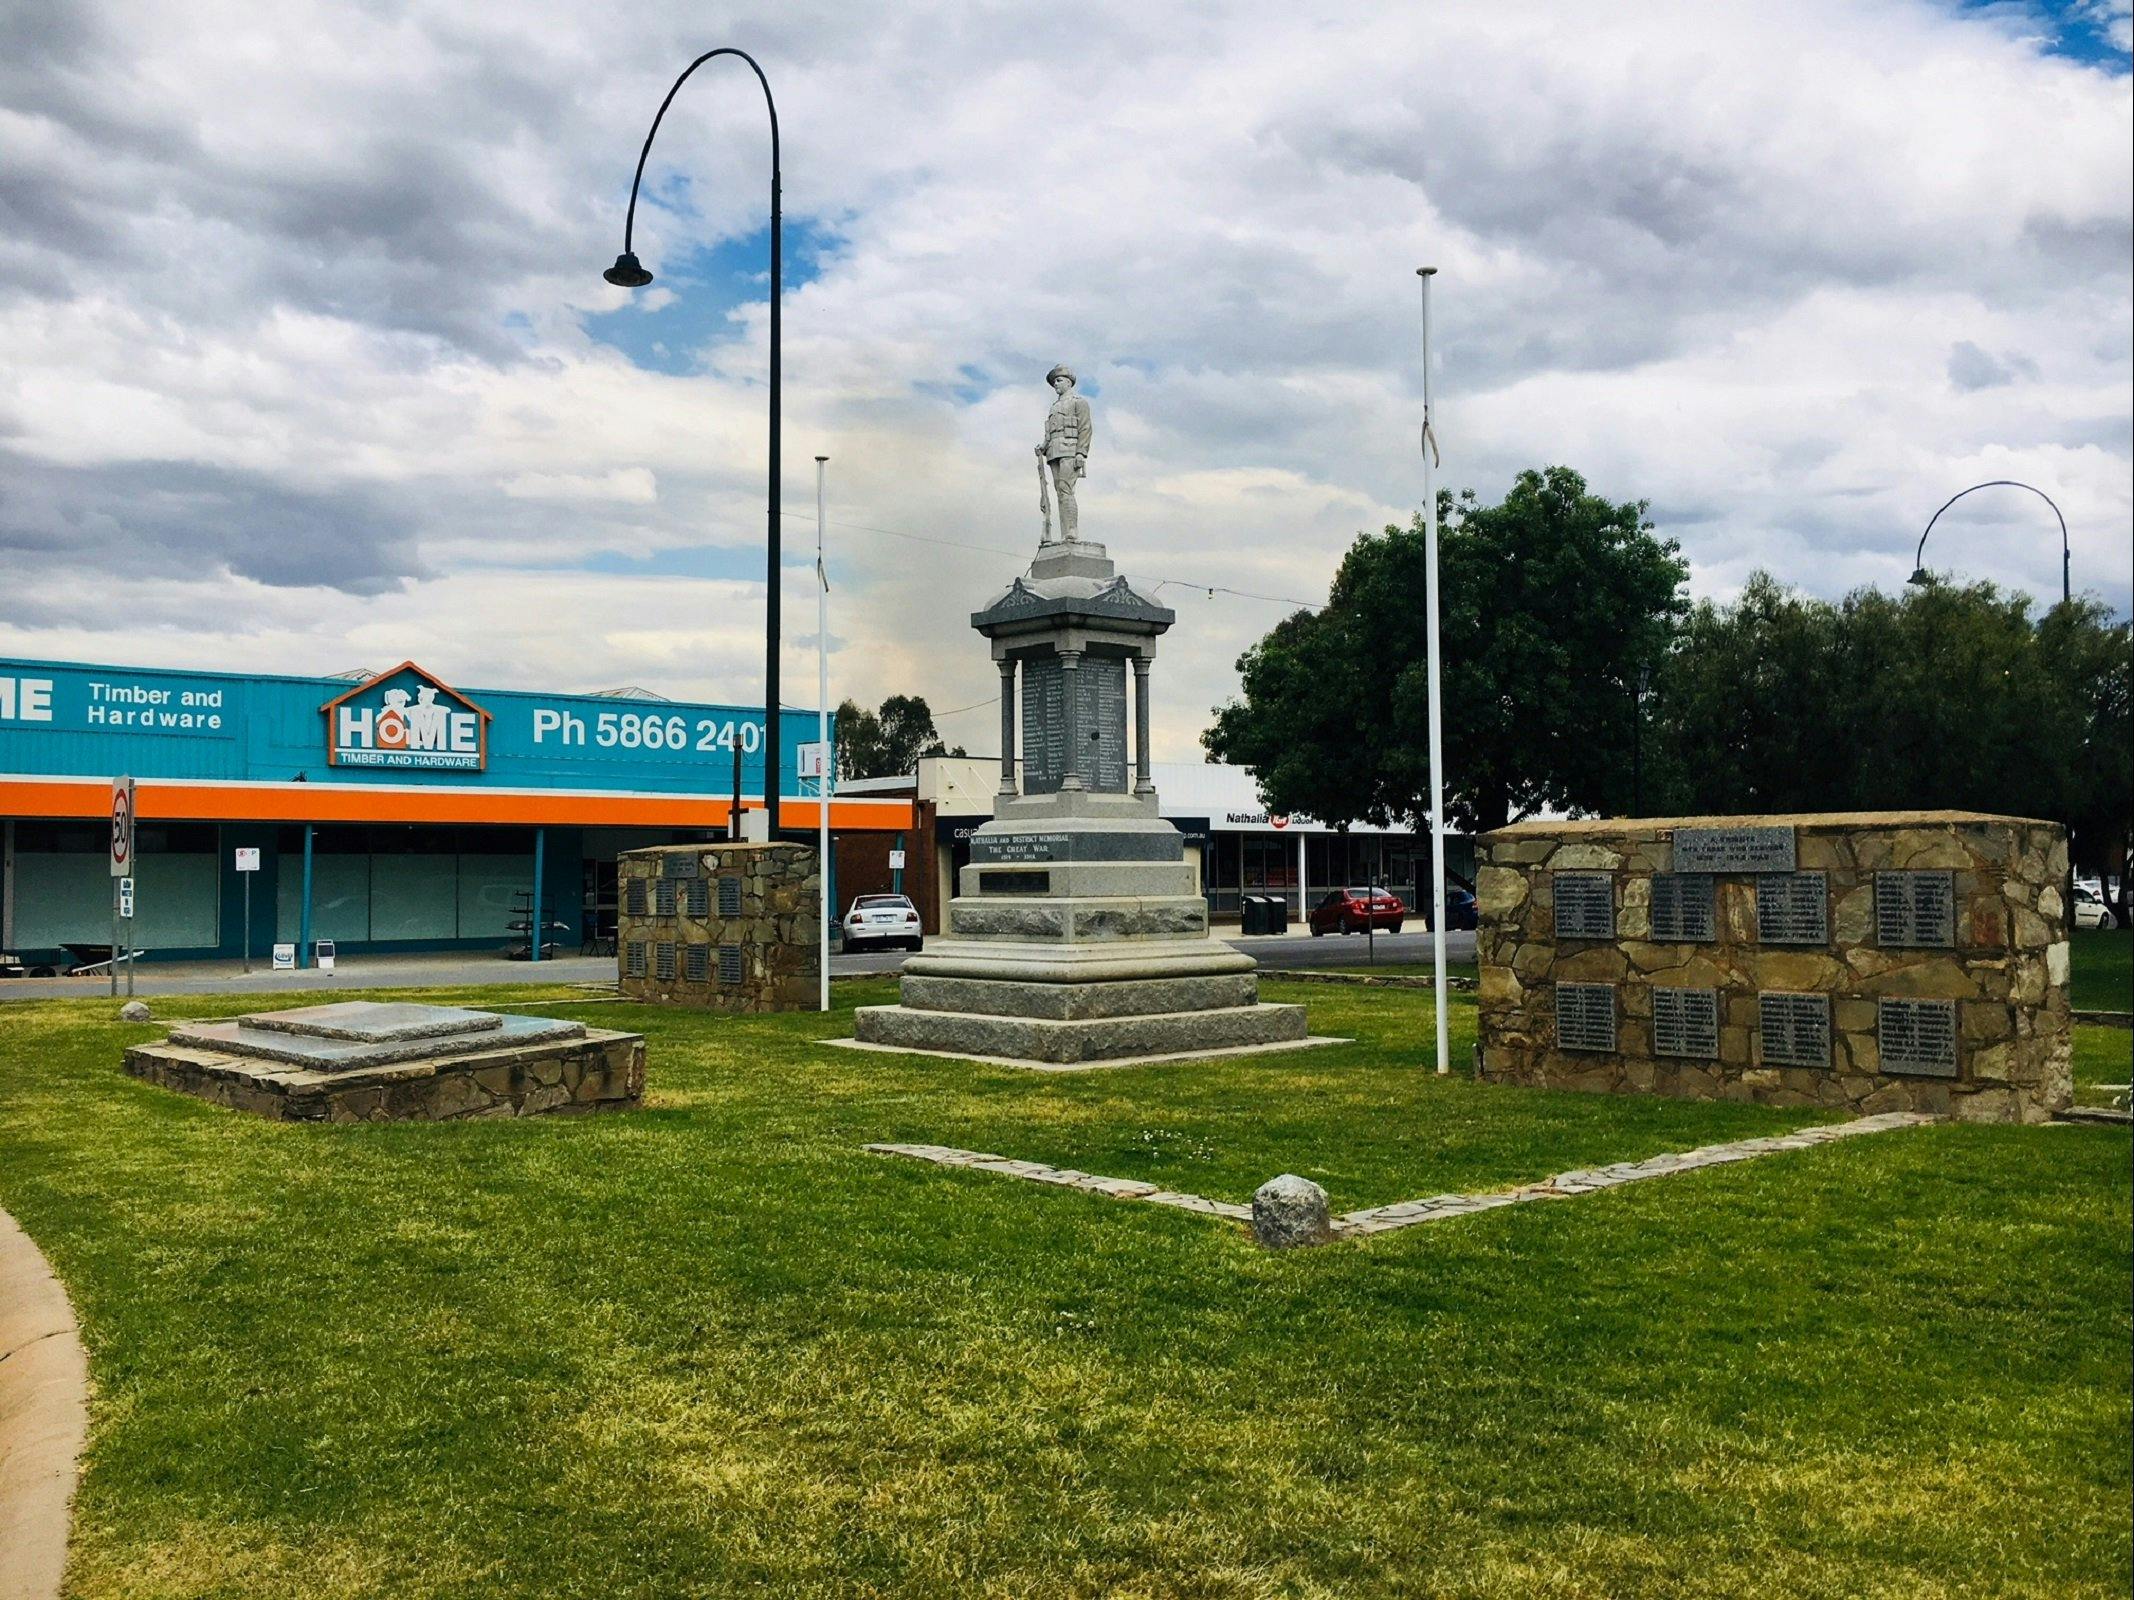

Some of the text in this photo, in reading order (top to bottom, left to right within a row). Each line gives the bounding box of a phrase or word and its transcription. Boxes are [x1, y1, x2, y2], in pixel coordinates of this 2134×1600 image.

[88, 682, 222, 707] Timber and
[88, 705, 222, 729] Hardware
[339, 707, 477, 752] HOME
[533, 709, 585, 746] Ph
[596, 713, 686, 750] 5866
[340, 752, 477, 767] TIMBER AND HARDWARE
[114, 811, 126, 843] 50
[1226, 813, 1269, 824] Nathalia
[970, 836, 998, 844] NATHALIA
[1012, 834, 1037, 843] DISTRICT
[1038, 833, 1069, 842] MEMORIAL
[1006, 845, 1027, 853] GREAT
[1033, 844, 1049, 852] WAR
